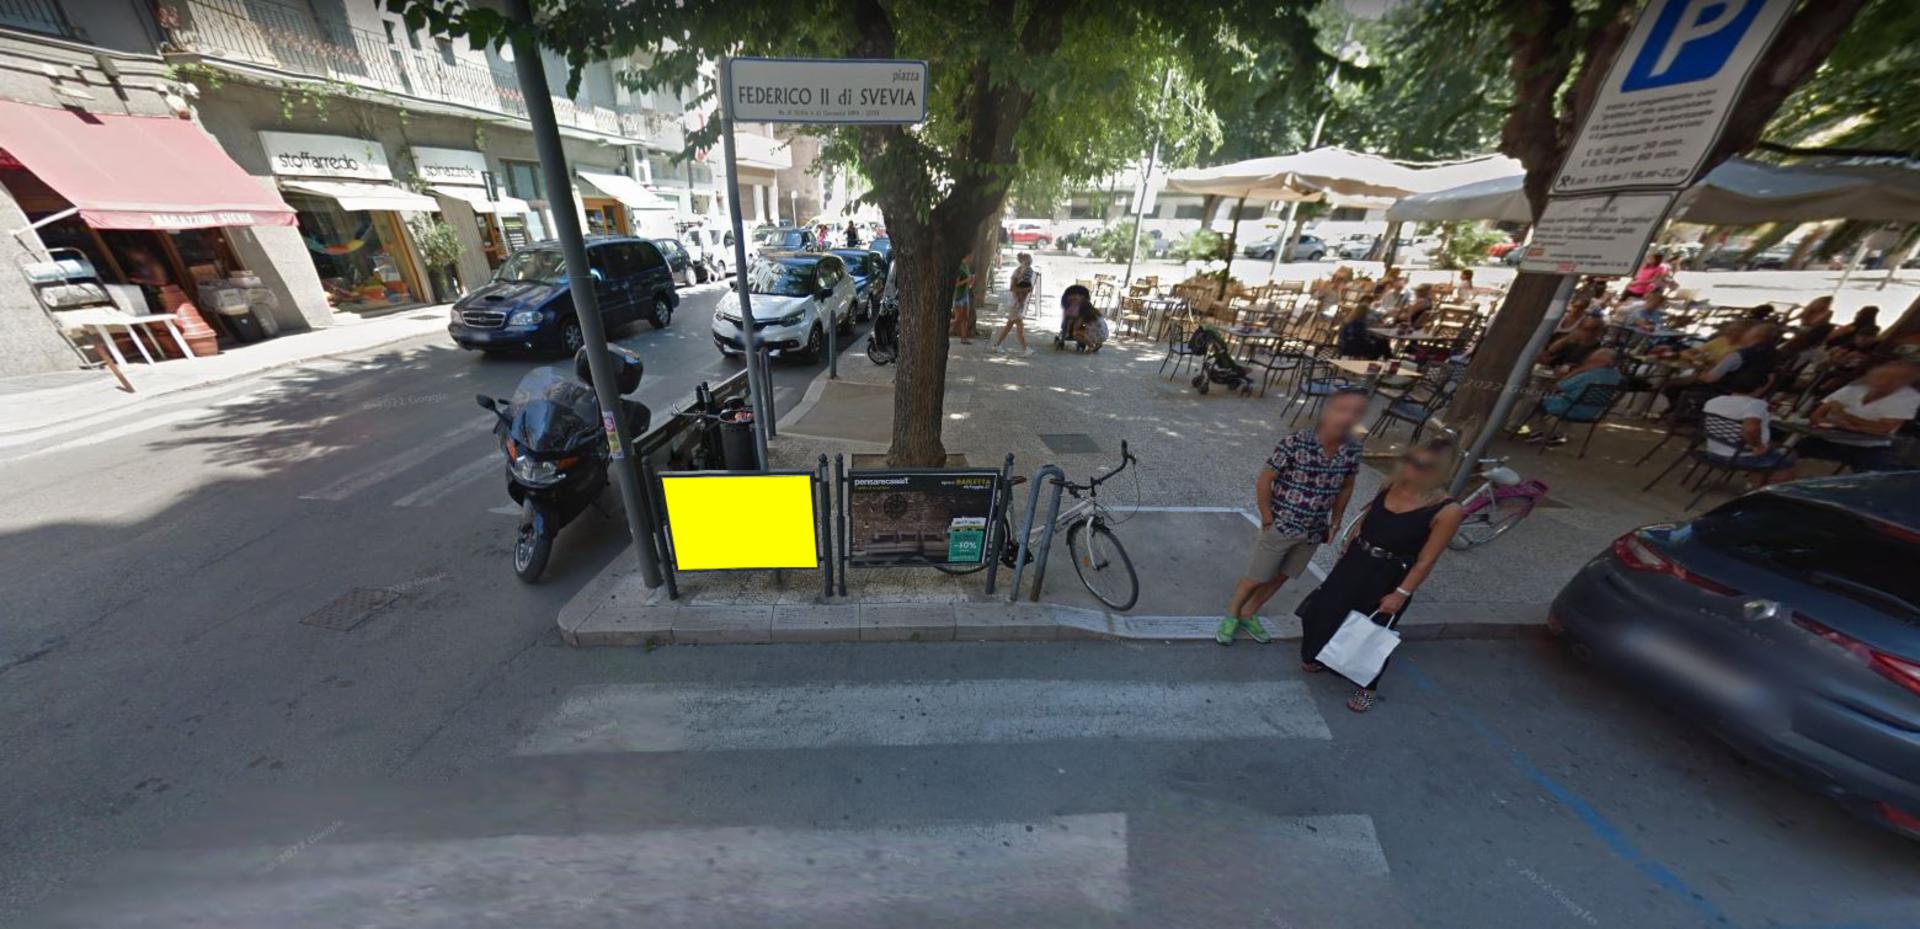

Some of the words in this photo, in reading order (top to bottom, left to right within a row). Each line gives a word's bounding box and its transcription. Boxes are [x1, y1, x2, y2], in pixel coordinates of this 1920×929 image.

[1648, 0, 1747, 77] P
[892, 69, 920, 83] piazza
[738, 86, 812, 105] FEDERICO
[821, 88, 829, 105] II
[838, 88, 852, 105] di
[860, 88, 916, 106] SVEVIA
[278, 152, 359, 171] stoffarredo
